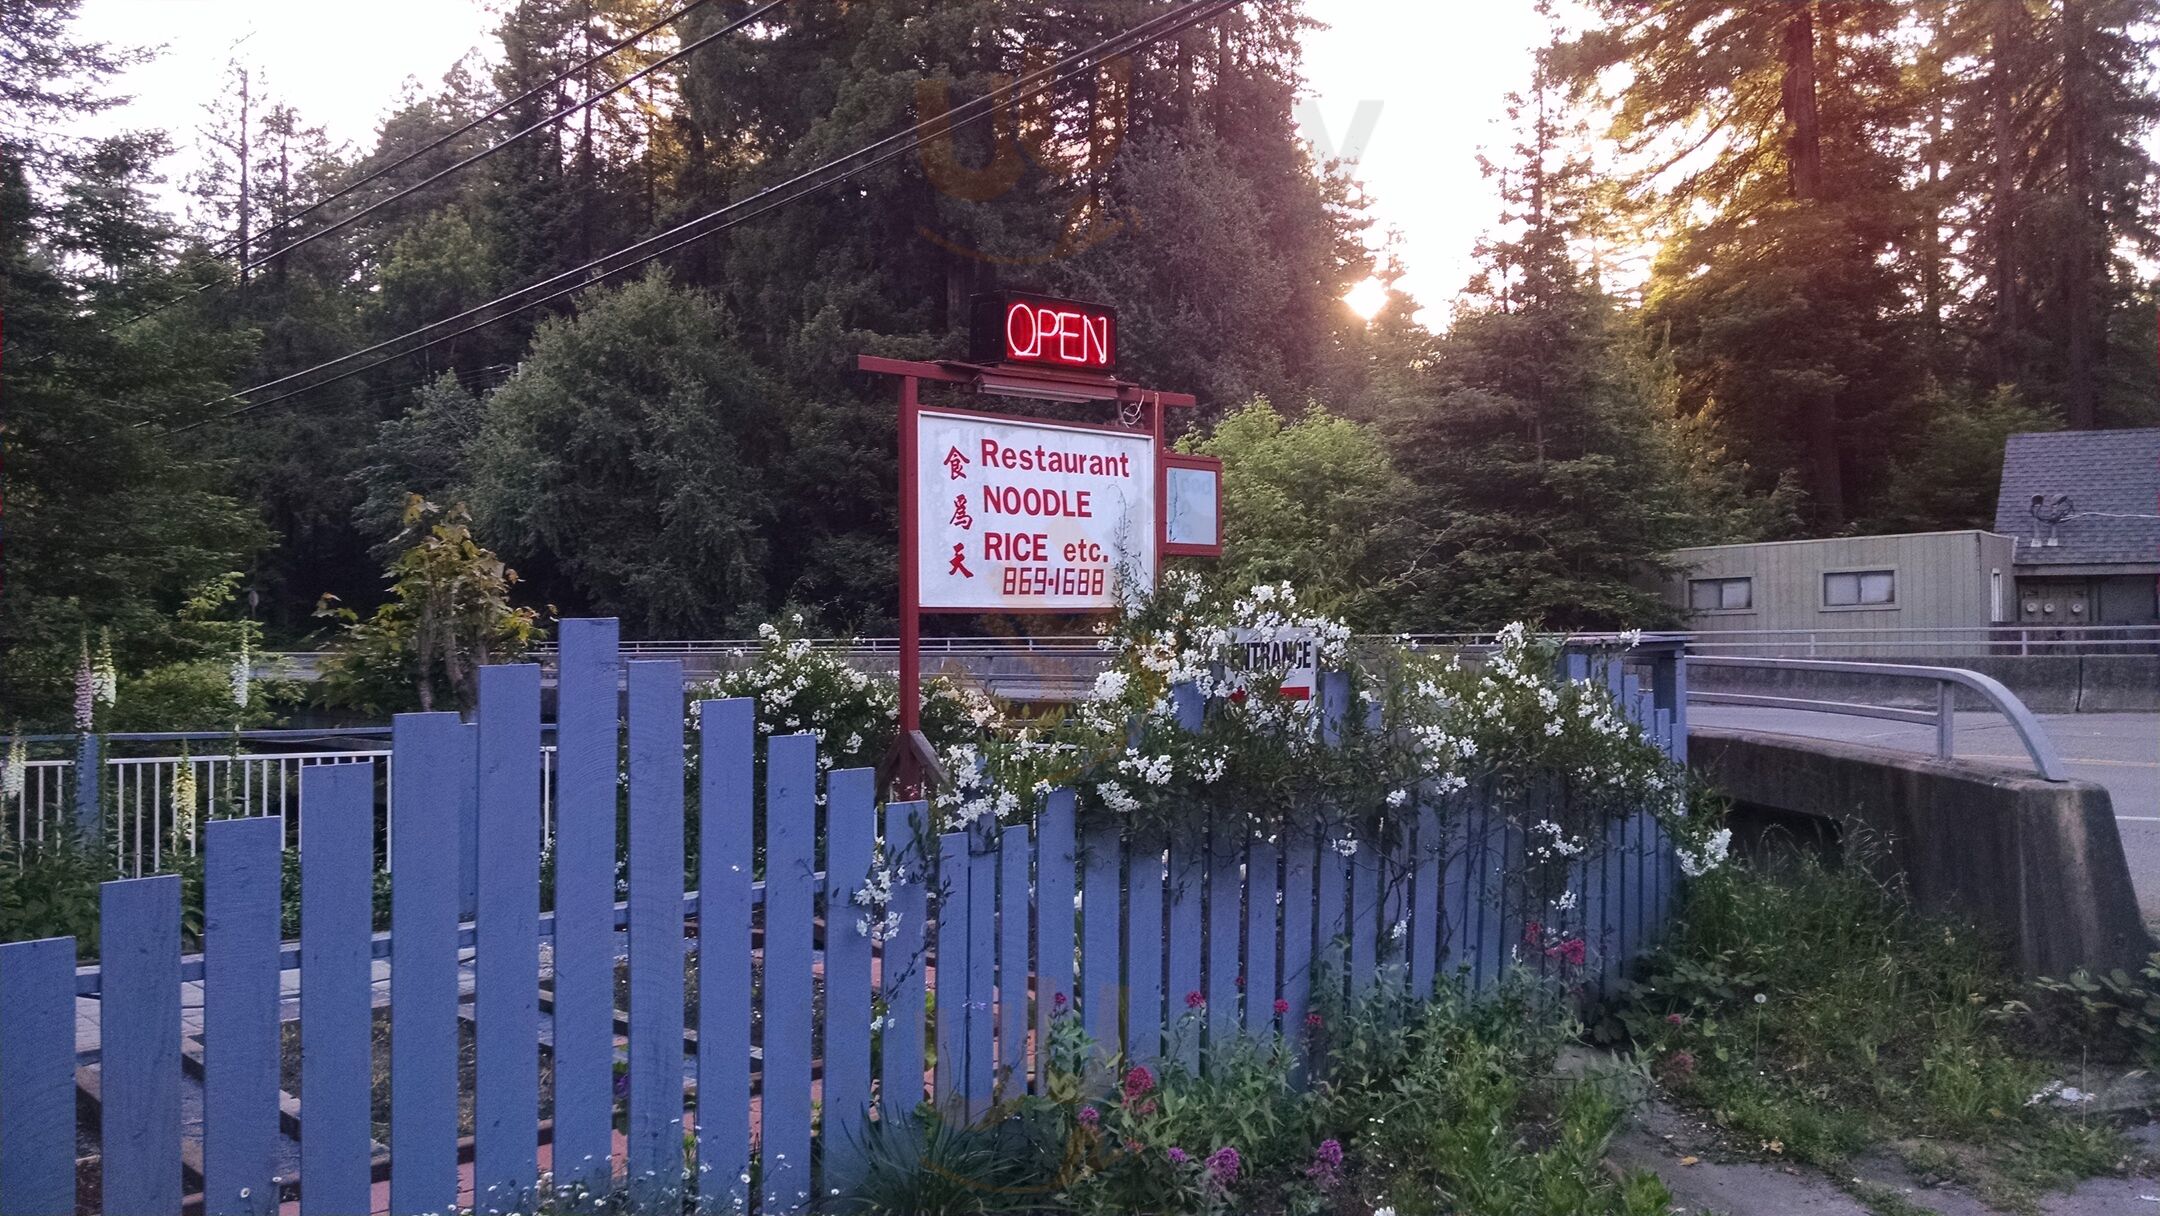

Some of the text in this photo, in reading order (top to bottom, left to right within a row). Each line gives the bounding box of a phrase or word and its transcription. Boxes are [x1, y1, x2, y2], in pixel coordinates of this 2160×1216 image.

[1007, 303, 1108, 364] OPEN
[981, 438, 1130, 478] Restaurant
[983, 485, 1093, 518] NOODLE
[984, 532, 1109, 563] RICE etc.
[1232, 640, 1311, 671] NTRANCE
